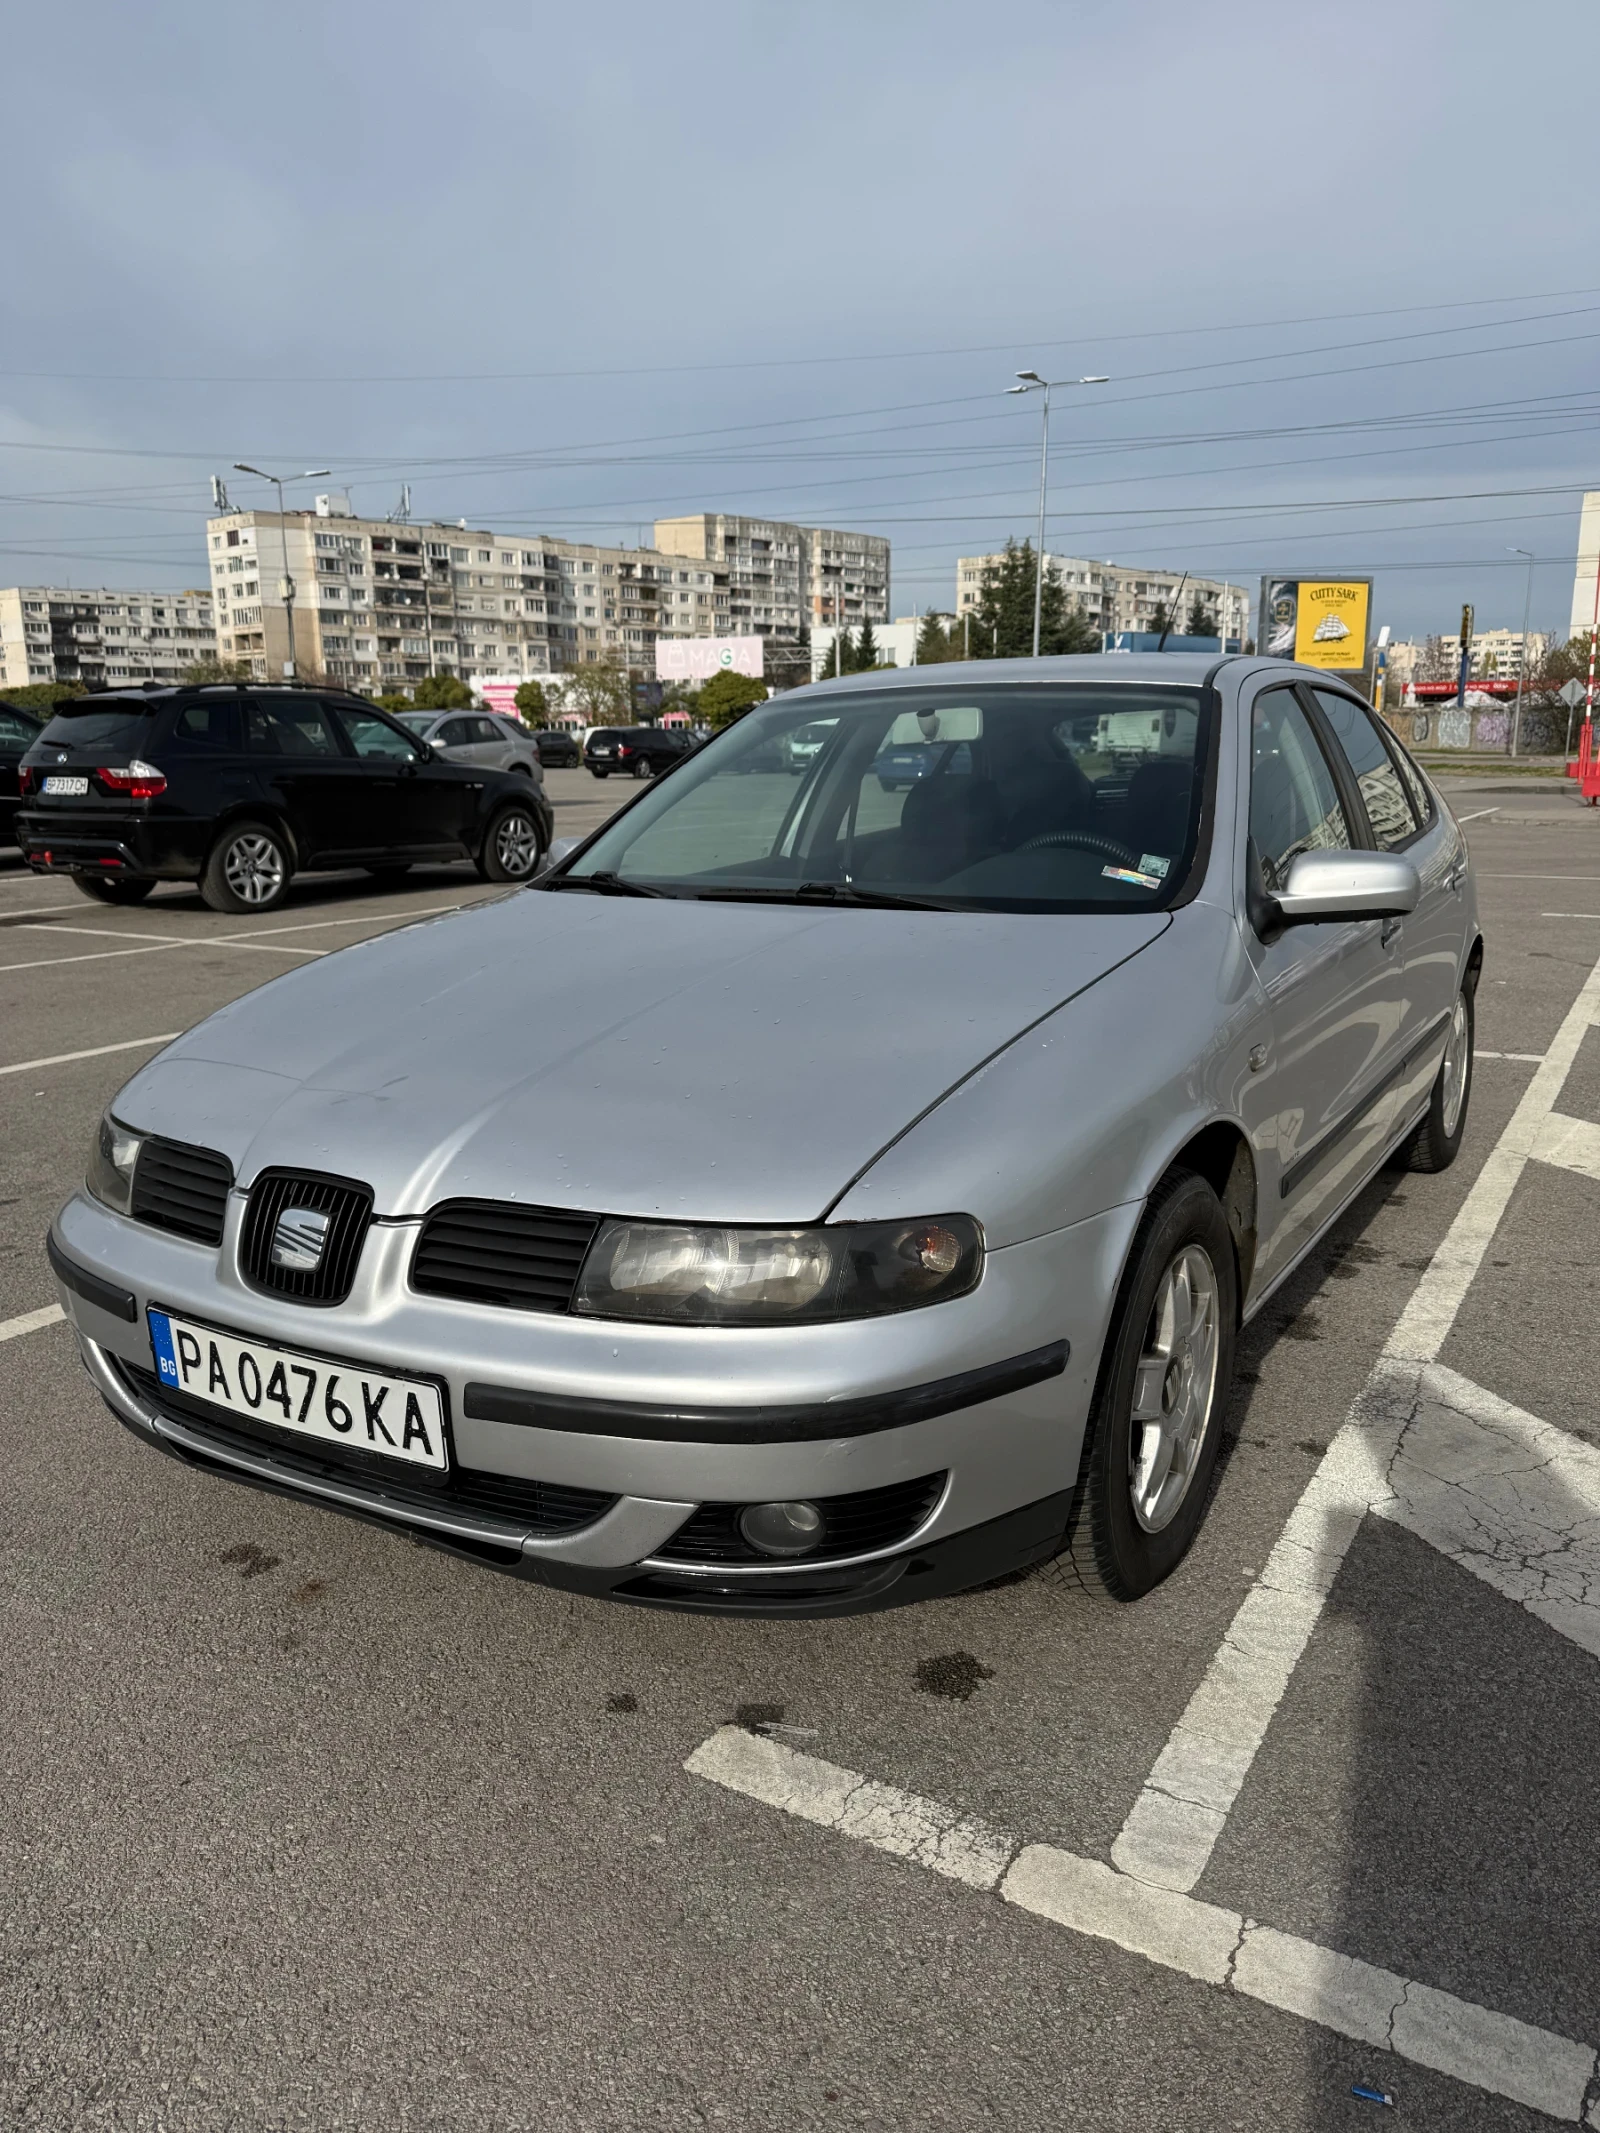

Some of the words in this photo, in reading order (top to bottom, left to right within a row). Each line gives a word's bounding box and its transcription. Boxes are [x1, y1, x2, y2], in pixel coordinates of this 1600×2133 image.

[1310, 587, 1336, 601] CUTTY
[1336, 587, 1358, 602] SARK
[689, 647, 751, 667] MAGA
[160, 1356, 176, 1376] BG
[176, 1329, 434, 1456] PA0476KA
